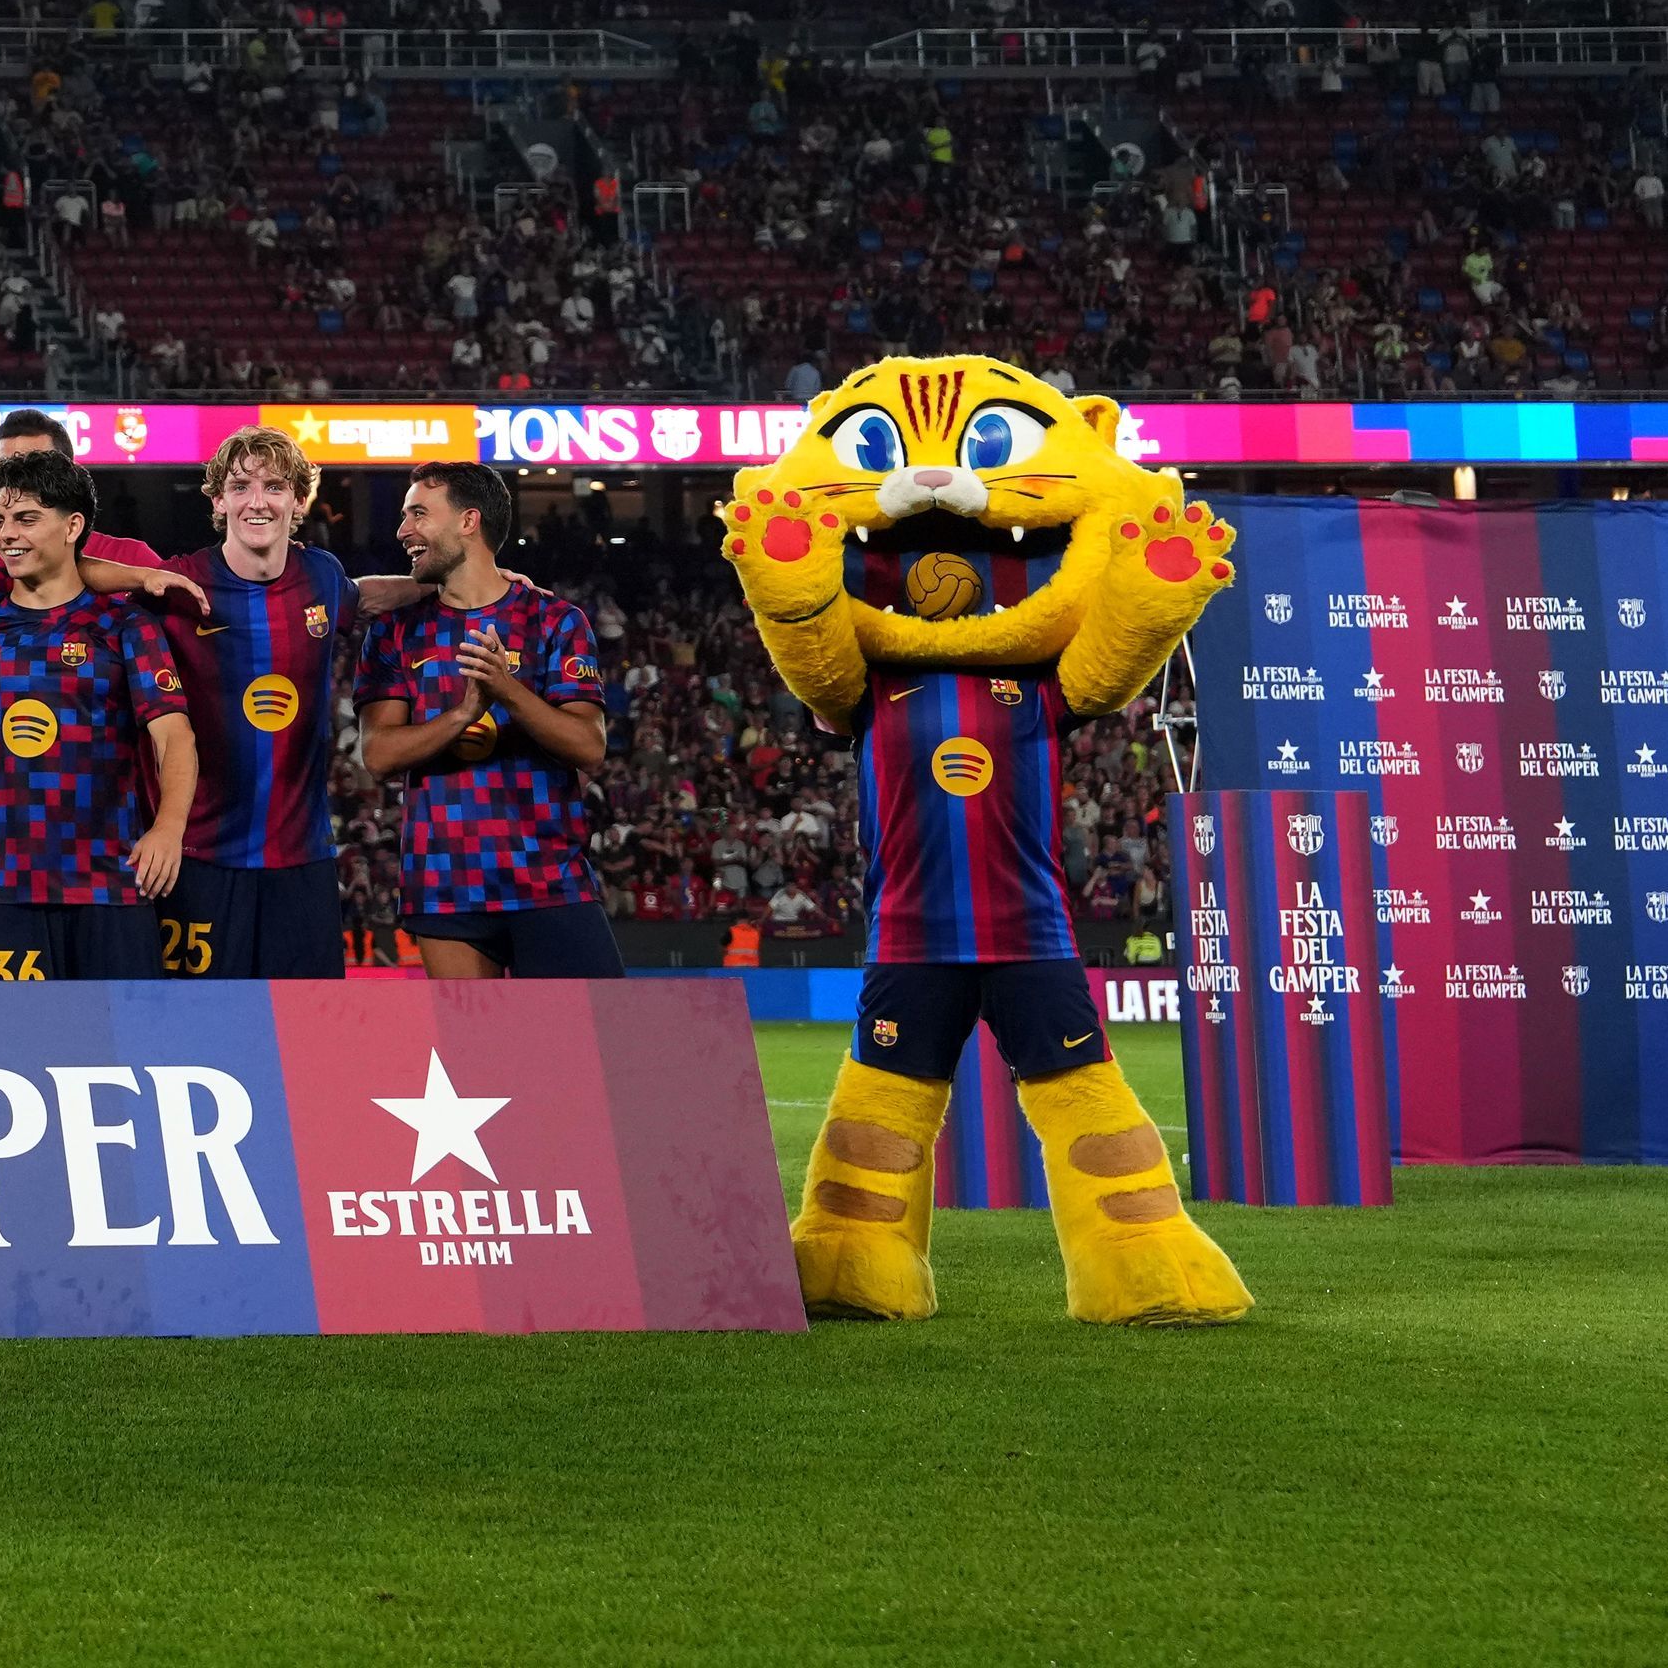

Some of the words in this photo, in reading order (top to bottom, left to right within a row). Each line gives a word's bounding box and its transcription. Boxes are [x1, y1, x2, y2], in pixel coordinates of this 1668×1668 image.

[720, 410, 765, 456] LA
[1329, 595, 1343, 610] LA
[1348, 595, 1384, 610] FESTA
[1506, 597, 1522, 612] LA
[1526, 597, 1561, 613] FESTA
[1329, 613, 1352, 627] DEL
[1356, 613, 1408, 628] GAMPER
[1438, 616, 1478, 625] ESTRELLA
[1507, 615, 1530, 630] DEL
[1534, 615, 1585, 630] GAMPER
[1243, 667, 1258, 682] LA
[1263, 667, 1301, 682] FESTA
[1425, 669, 1440, 684] LA
[1444, 669, 1480, 685] FESTA
[1601, 671, 1617, 686] LA
[1620, 671, 1656, 686] FESTA
[1243, 684, 1267, 699] DEL
[1271, 685, 1325, 700] GAMPER
[1354, 689, 1395, 697] ESTRELLA
[1425, 687, 1449, 701] DEL
[1452, 687, 1504, 702] GAMPER
[1601, 689, 1625, 703] DEL
[1340, 741, 1356, 757] LA
[1359, 742, 1396, 757] FESTA
[1520, 743, 1535, 758] LA
[1539, 743, 1575, 759] FESTA
[1268, 761, 1310, 769] ESTRELLA
[1340, 759, 1364, 774] DEL
[1367, 760, 1420, 775] GAMPER
[1520, 761, 1544, 776] DEL
[1547, 761, 1599, 777] GAMPER
[1436, 816, 1452, 832] LA
[1456, 816, 1493, 832] FESTA
[1614, 817, 1631, 833] LA
[1436, 834, 1460, 849] DEL
[1464, 834, 1516, 850] GAMPER
[1546, 837, 1586, 846] ESTRELLA
[1615, 835, 1639, 850] DEL
[1200, 882, 1216, 907] LA
[1296, 882, 1323, 908] LA
[1531, 891, 1549, 906] LA
[1551, 891, 1588, 906] FESTA
[1191, 910, 1229, 936] FESTA
[1280, 910, 1343, 936] FESTA
[1377, 907, 1431, 923] GAMPER
[1461, 911, 1502, 920] ESTRELLA
[1532, 909, 1556, 924] DEL
[1559, 909, 1612, 924] GAMPER
[162, 920, 212, 973] 25
[1199, 938, 1224, 963] DEL
[1293, 938, 1334, 964] DEL
[1187, 966, 1240, 991] GAMPER
[1270, 966, 1360, 992] GAMPER
[1445, 965, 1463, 980] LA
[1465, 965, 1503, 981] FESTA
[1626, 966, 1642, 981] LA
[1445, 983, 1470, 998] DEL
[1473, 983, 1526, 999] GAMPER
[1626, 984, 1649, 999] DEL
[1105, 980, 1146, 1022] LA
[327, 1190, 591, 1235] ESTRELLA
[419, 1242, 512, 1265] DAMM
